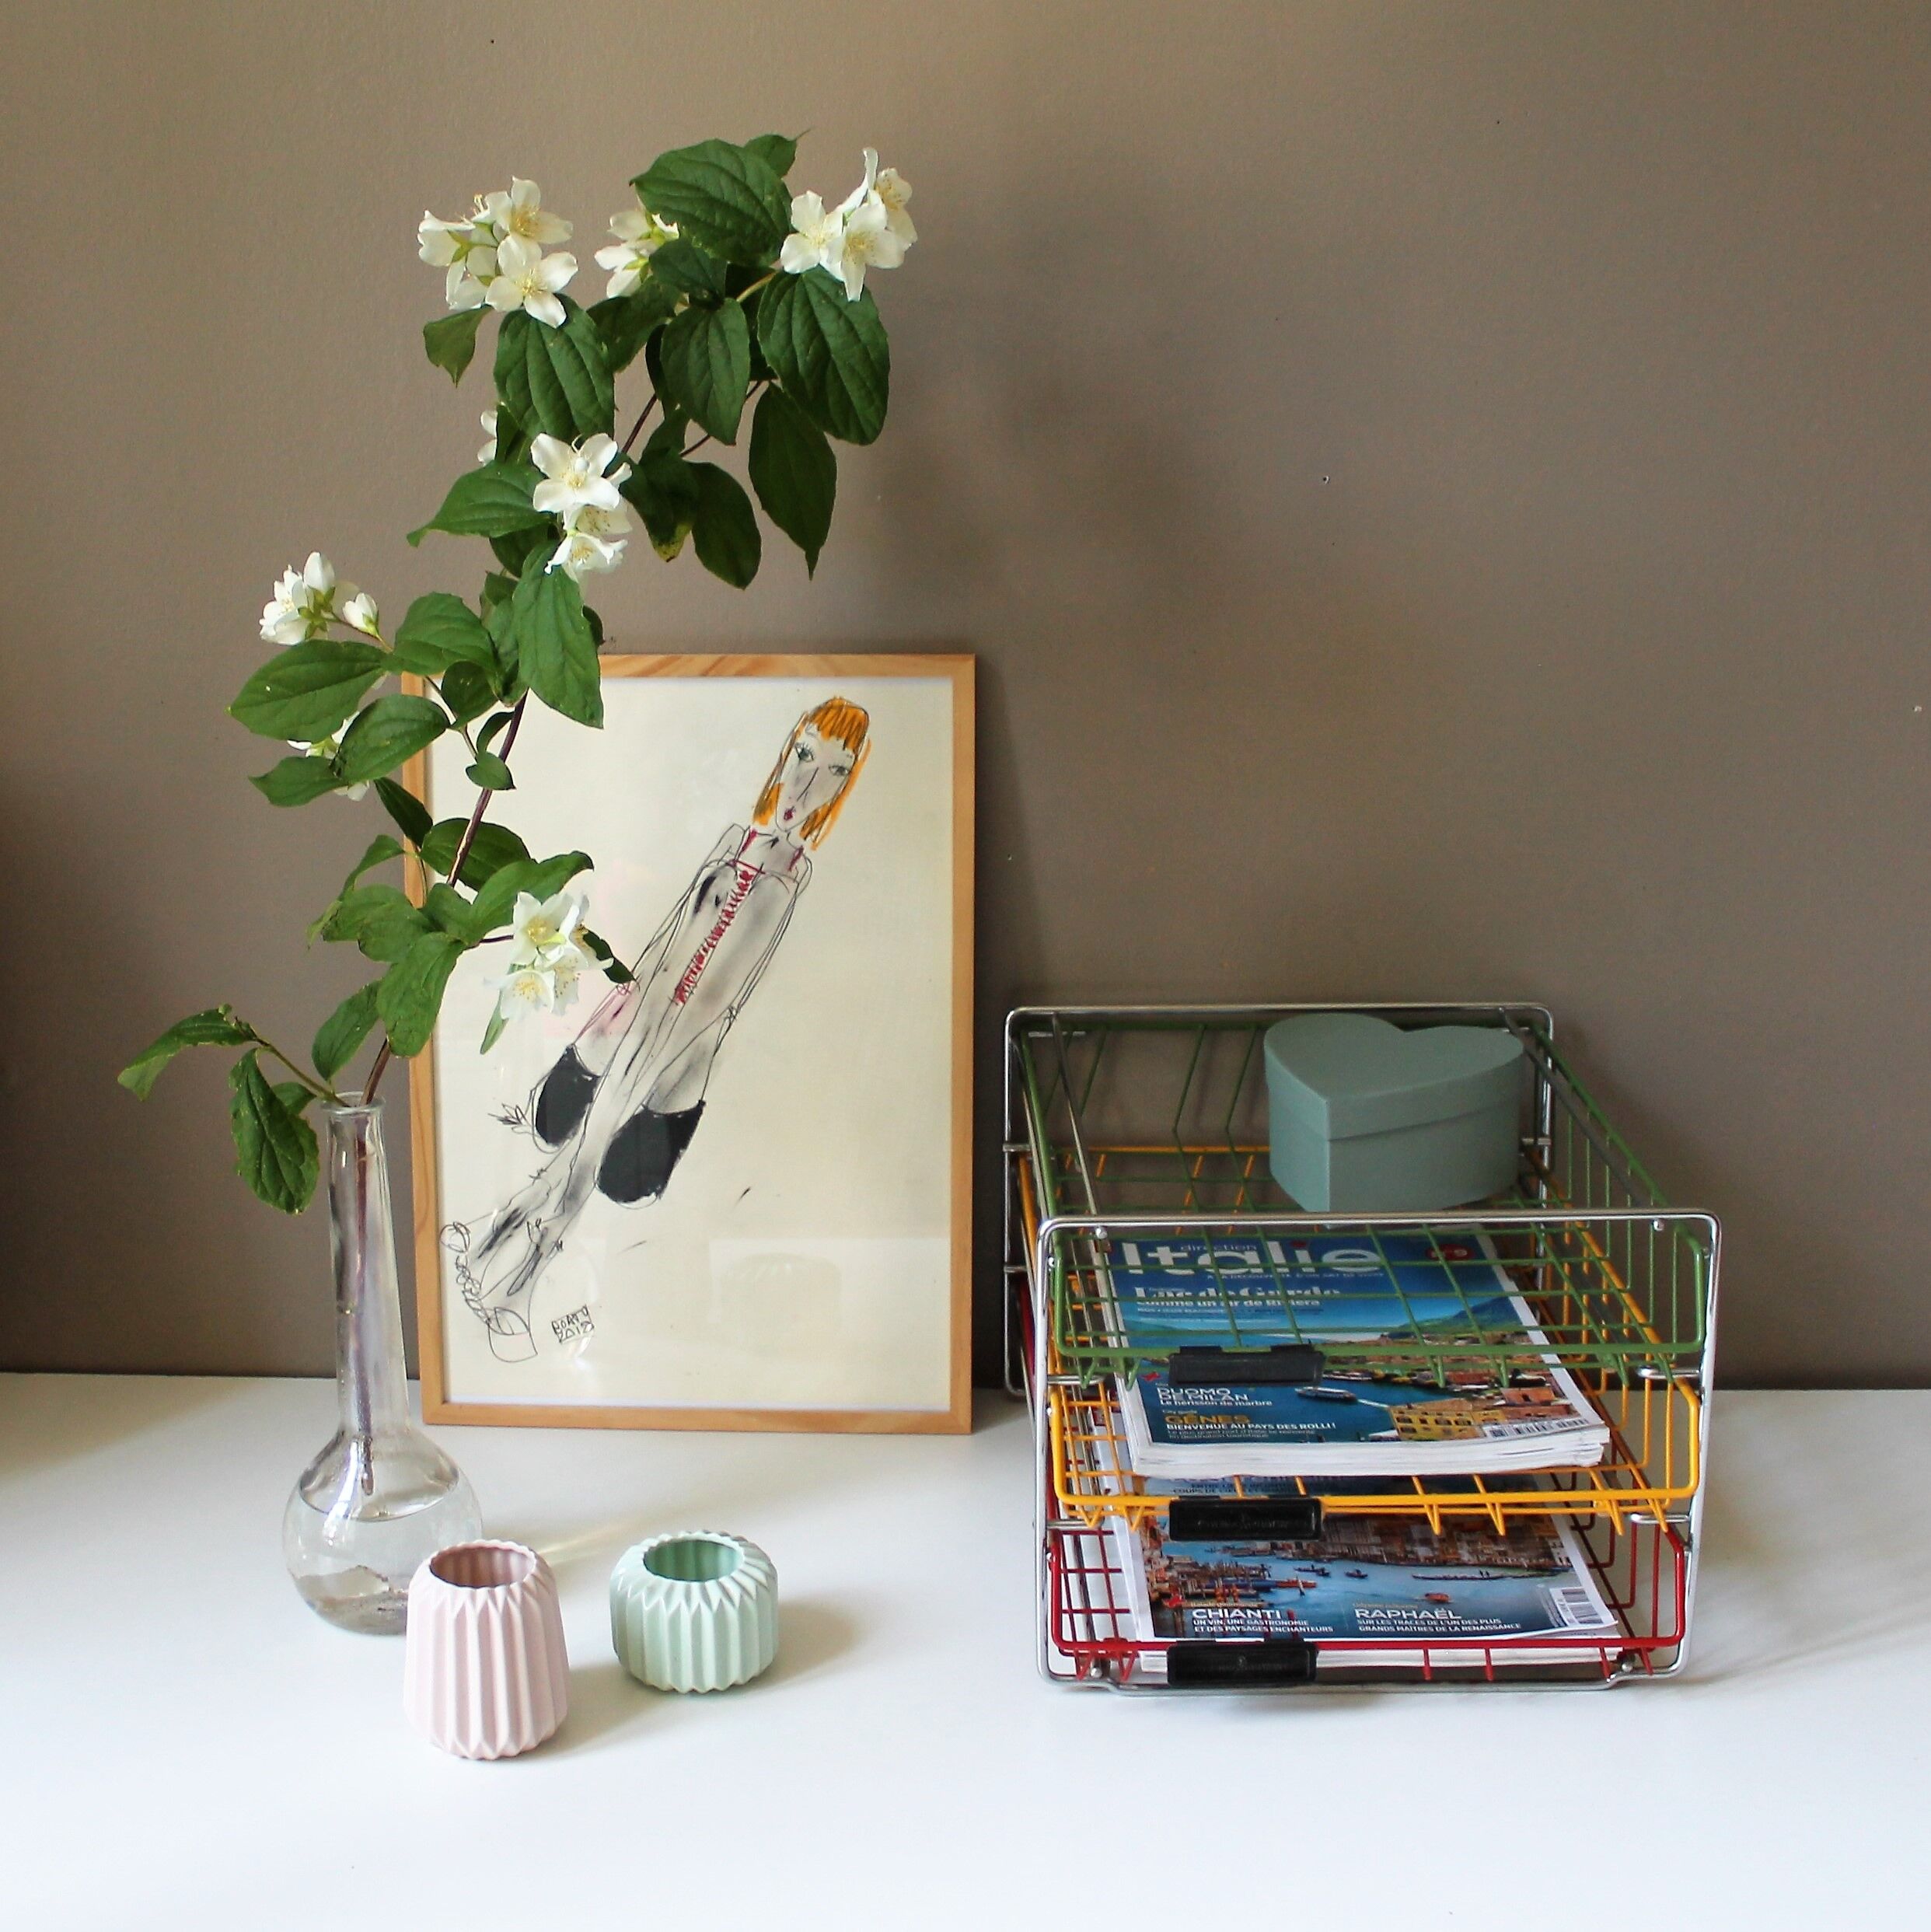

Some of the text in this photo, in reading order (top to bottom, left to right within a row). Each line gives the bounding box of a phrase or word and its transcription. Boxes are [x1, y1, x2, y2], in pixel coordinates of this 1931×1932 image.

[1122, 1240, 1382, 1274] Italie
[1266, 1298, 1321, 1307] Riiera
[1192, 1609, 1282, 1619] CHIANTI
[1354, 1607, 1462, 1619] RAPHAËL
